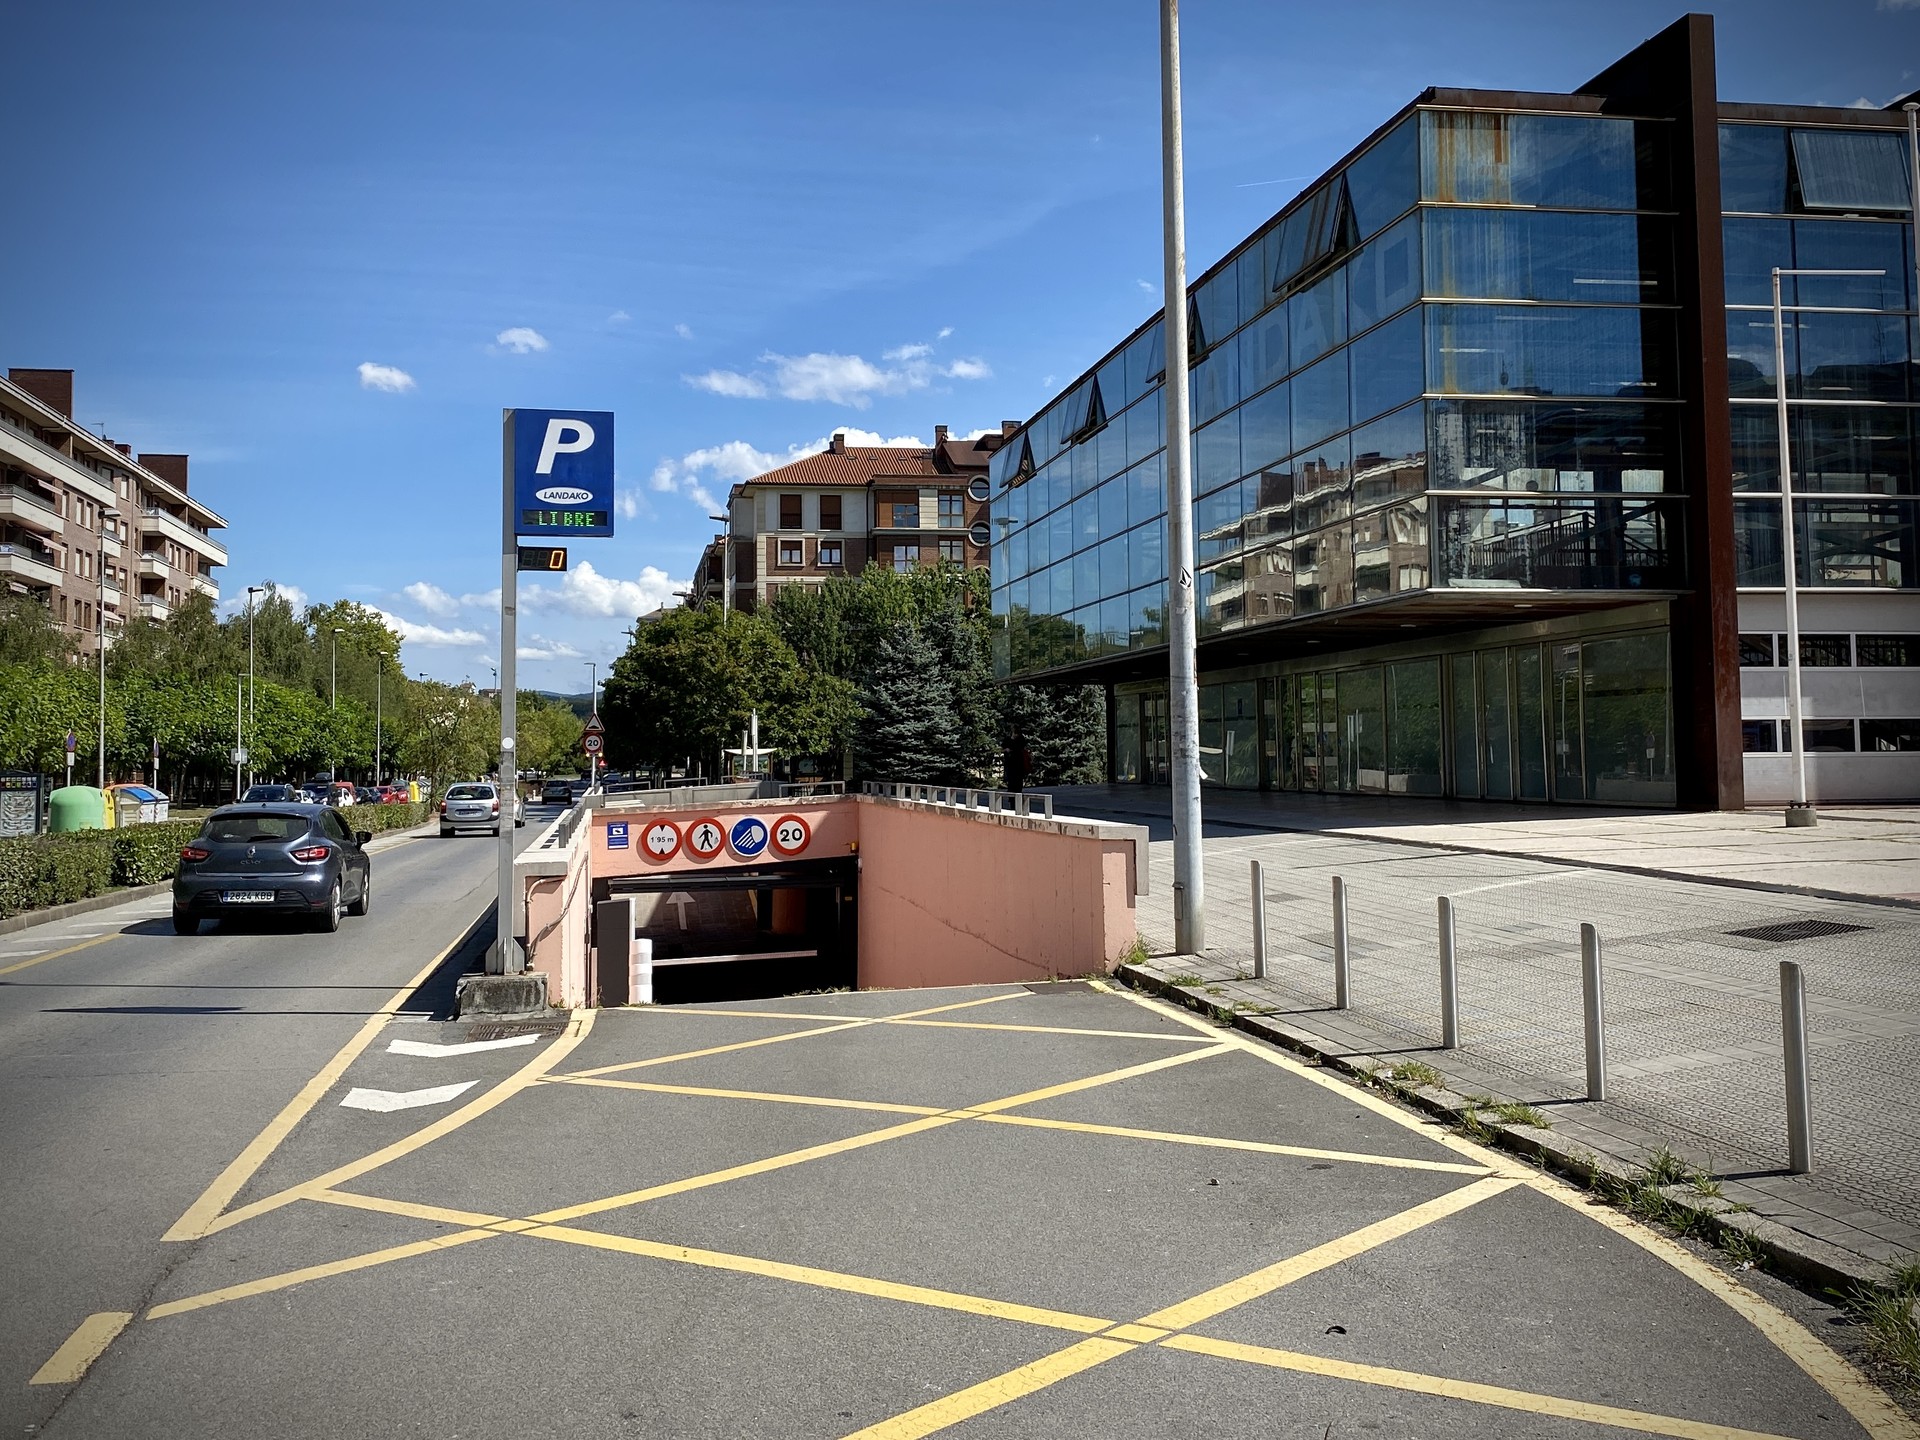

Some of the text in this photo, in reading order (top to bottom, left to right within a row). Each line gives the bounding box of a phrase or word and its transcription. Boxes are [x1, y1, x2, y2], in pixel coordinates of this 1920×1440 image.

[1193, 219, 1421, 424] ANDAKO
[535, 418, 595, 475] P
[543, 490, 589, 500] LANDAKO
[538, 511, 595, 527] LIBRE
[549, 550, 565, 569] 0
[587, 739, 599, 747] 20
[780, 828, 803, 842] 20
